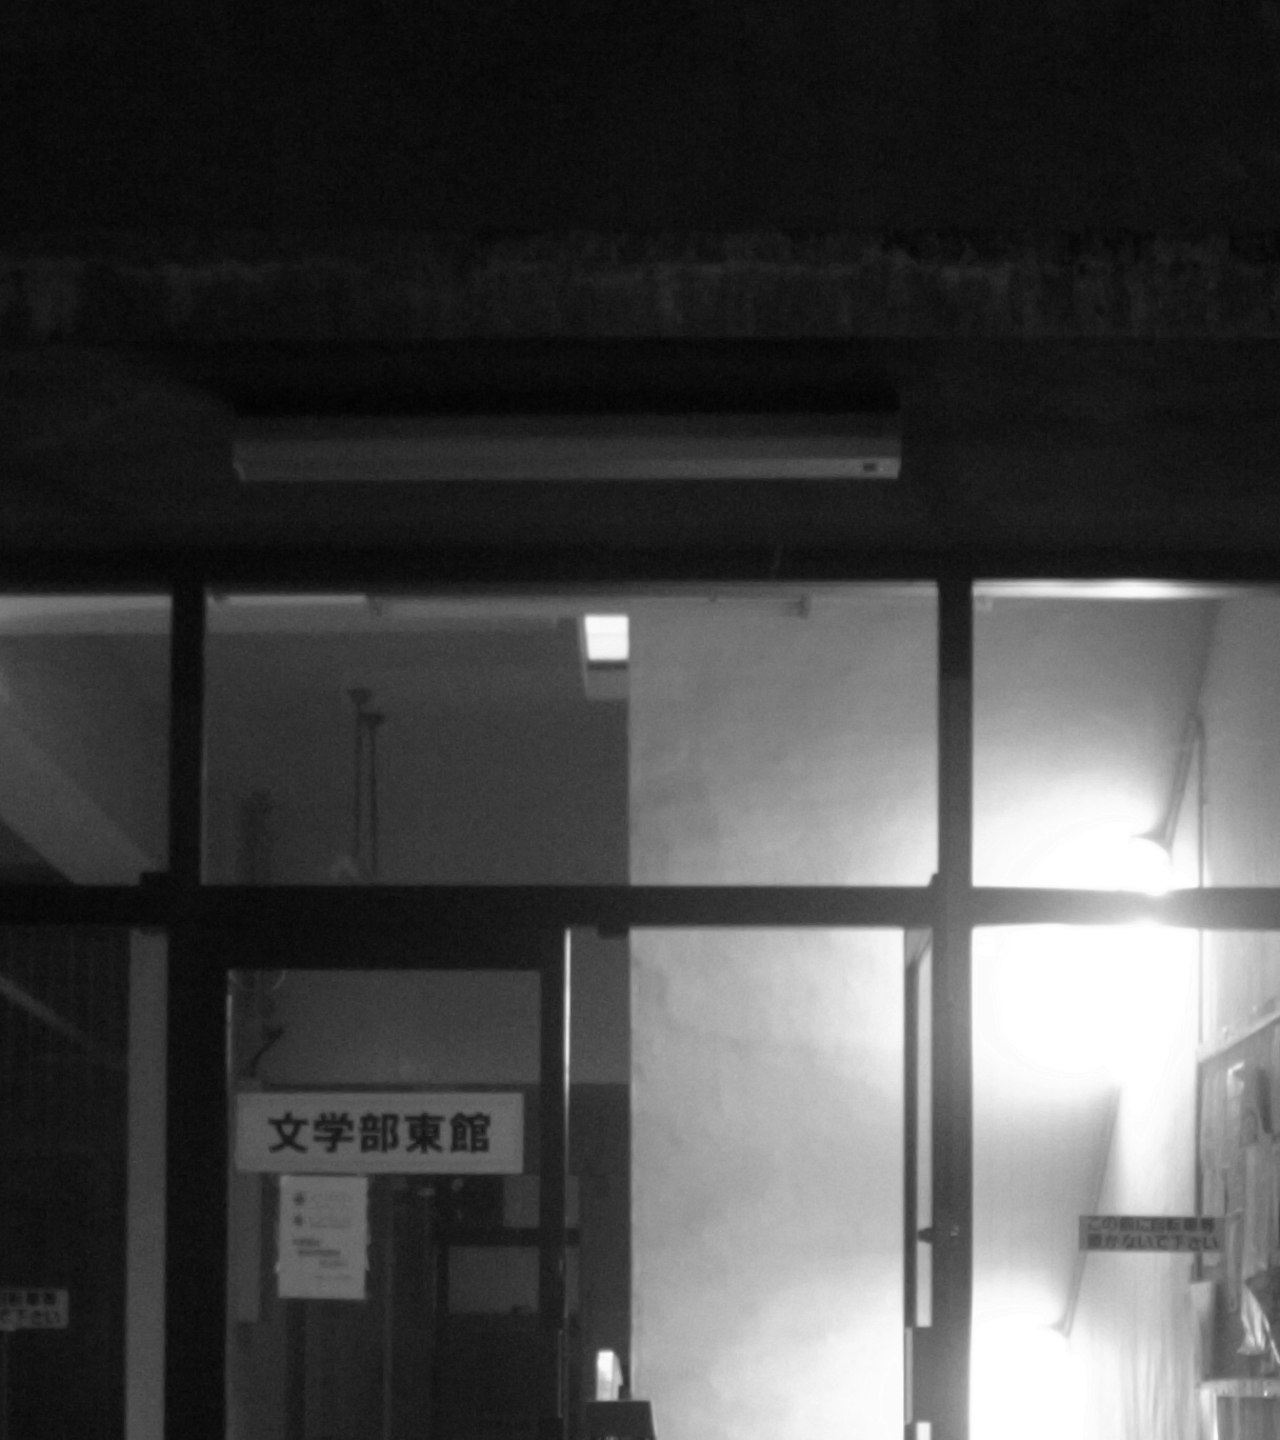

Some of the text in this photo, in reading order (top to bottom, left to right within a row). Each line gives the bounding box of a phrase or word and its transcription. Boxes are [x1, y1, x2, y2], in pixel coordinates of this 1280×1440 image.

[268, 1112, 490, 1153] 文学部東館
